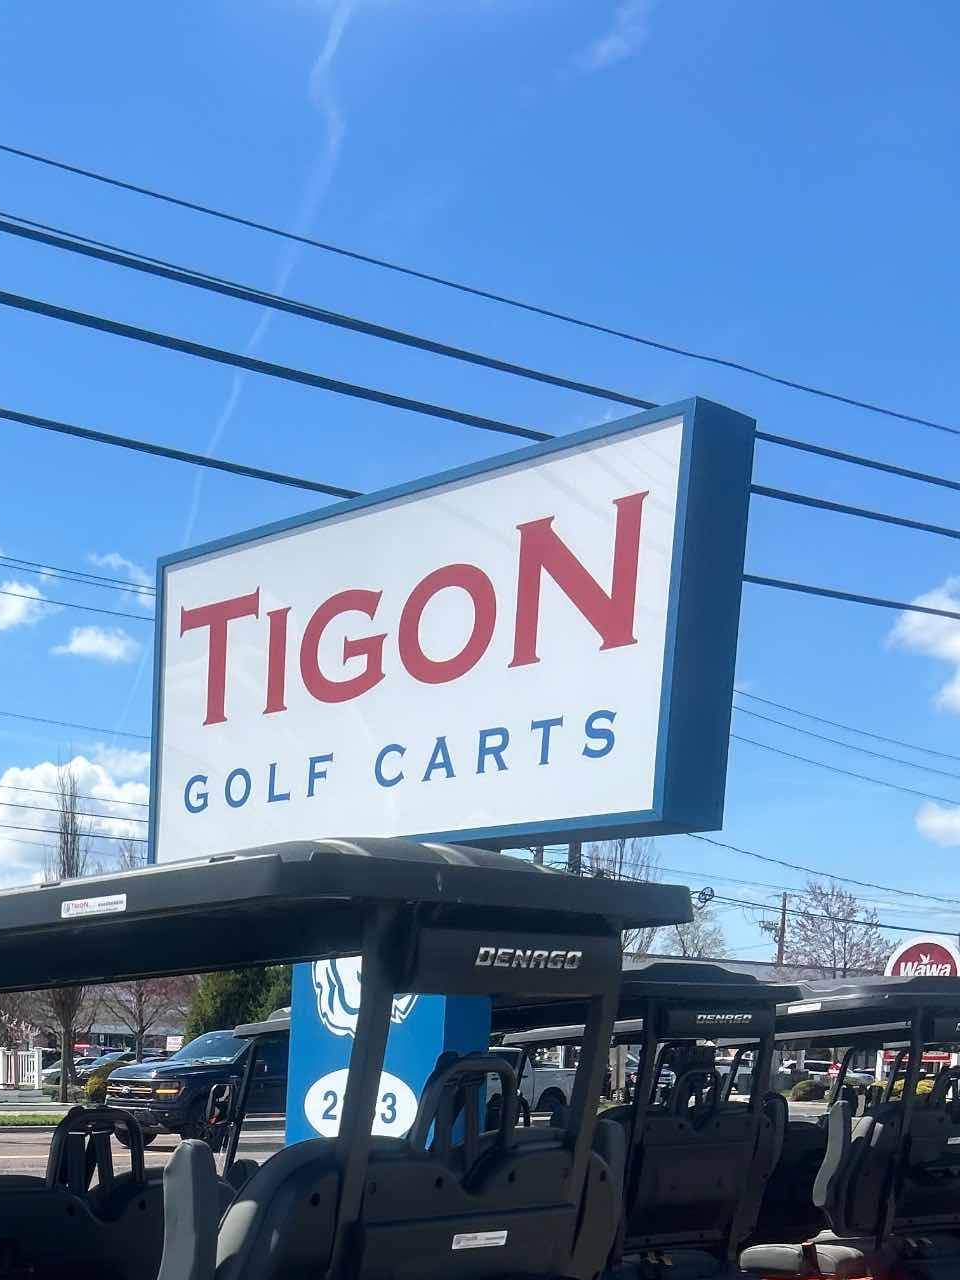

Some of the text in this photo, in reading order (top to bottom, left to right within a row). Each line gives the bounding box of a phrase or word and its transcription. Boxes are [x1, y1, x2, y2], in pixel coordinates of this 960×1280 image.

[180, 490, 650, 726] TIGON
[184, 709, 618, 815] GOLF CARTS
[475, 946, 583, 969] DENAGO
[899, 961, 952, 977] Wawa
[321, 1090, 398, 1124] 23
